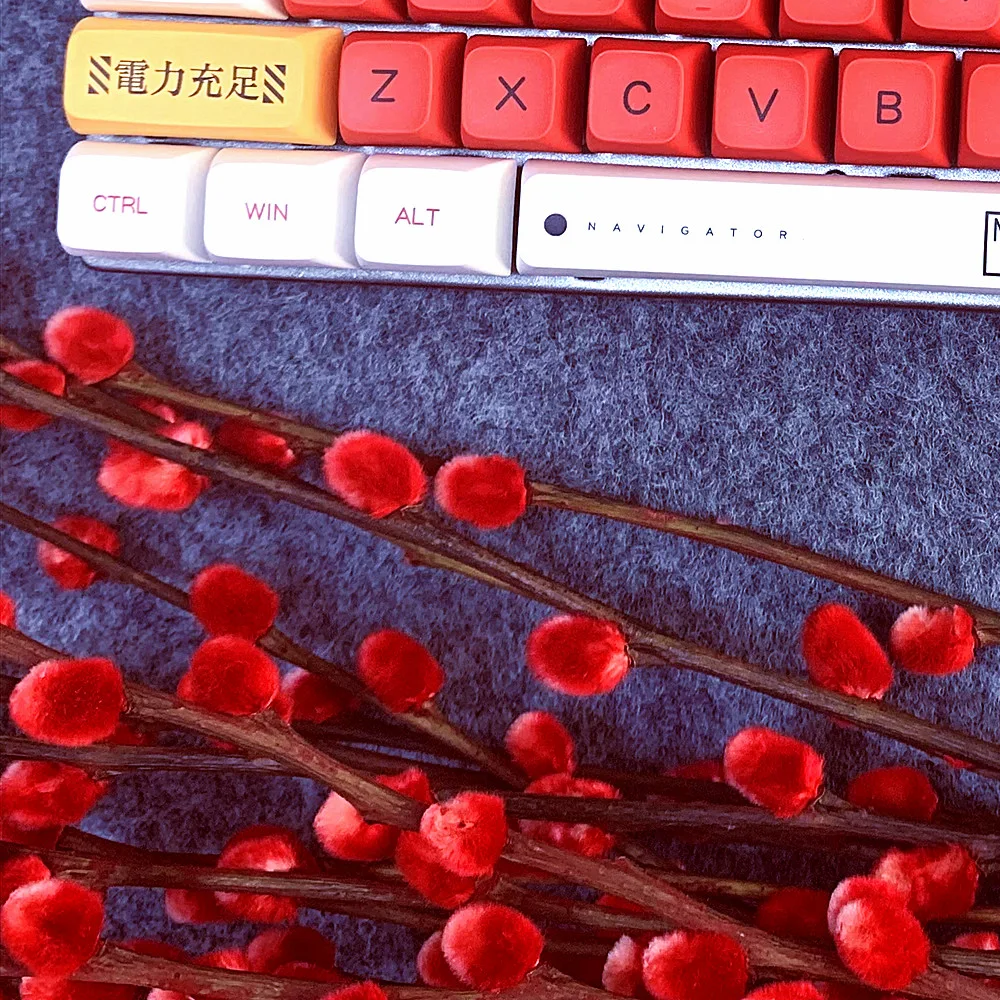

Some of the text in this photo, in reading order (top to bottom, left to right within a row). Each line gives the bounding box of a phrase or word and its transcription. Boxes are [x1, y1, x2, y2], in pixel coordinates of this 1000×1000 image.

[114, 59, 260, 101] 電力充足
[370, 69, 399, 103] Z
[495, 75, 528, 112] X
[622, 80, 652, 116] C
[747, 87, 779, 123] V
[876, 90, 903, 125] B
[93, 194, 148, 215] CTRL
[245, 202, 288, 221] WIN
[394, 207, 441, 227] ALT
